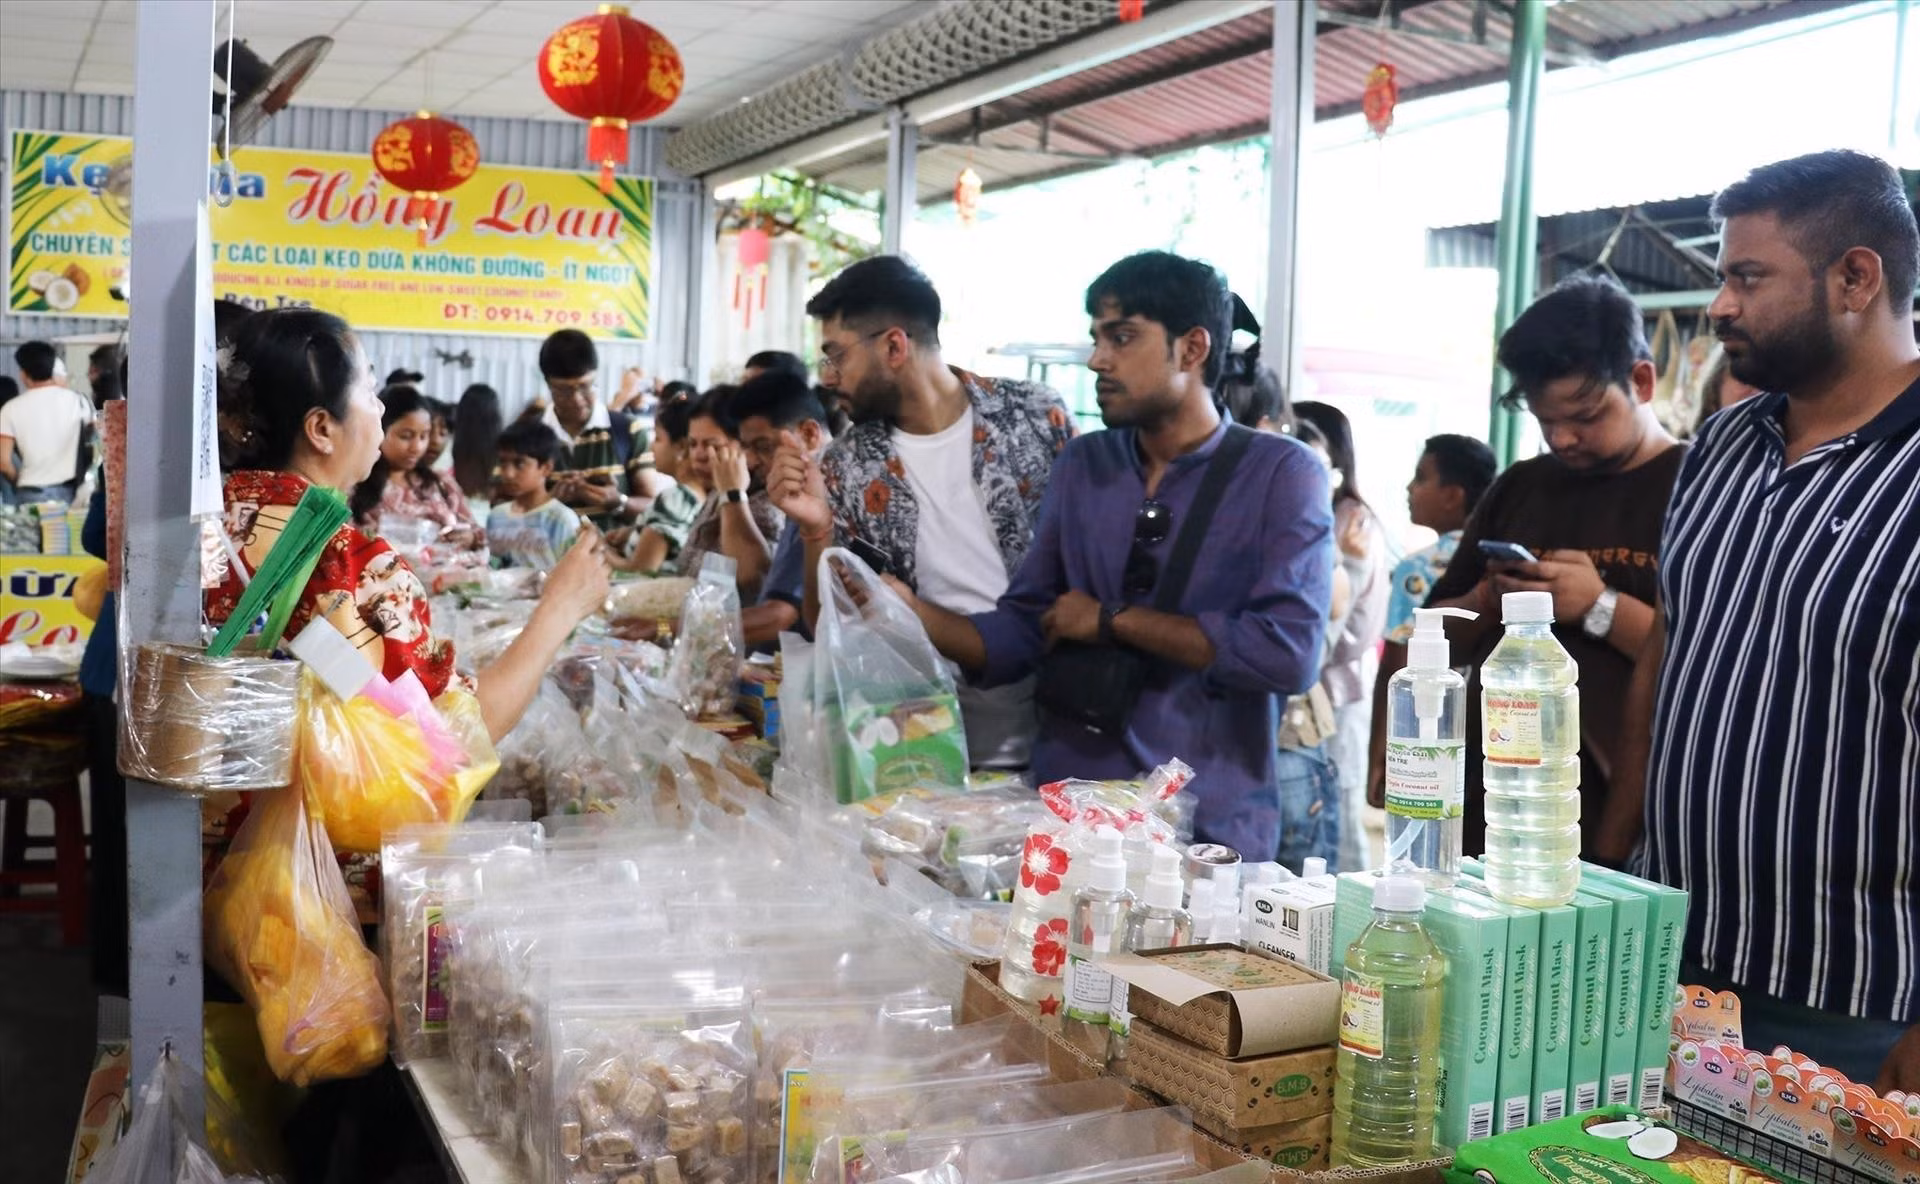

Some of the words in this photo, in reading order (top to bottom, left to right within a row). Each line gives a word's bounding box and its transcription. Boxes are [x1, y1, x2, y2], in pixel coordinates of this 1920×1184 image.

[474, 181, 621, 239] Loan
[31, 231, 113, 256] CHUYÊN
[228, 241, 267, 263] CÁC
[275, 246, 316, 270] LOẠI
[324, 249, 360, 274] KẸO
[367, 248, 404, 270] DỪA
[412, 251, 475, 274] KHÔNG
[483, 252, 544, 278] ĐƯỜNG
[586, 264, 630, 284] NGỌT
[1515, 944, 1526, 984] Mask
[1552, 940, 1563, 978] Mask
[1587, 933, 1598, 972] Mask
[1622, 927, 1633, 964] Mask
[1481, 948, 1494, 987] Mask
[1650, 963, 1668, 1030] Coconut
[1660, 921, 1674, 958] Mask
[1546, 983, 1560, 1052] Coconut
[1580, 977, 1595, 1045] Coconut
[1615, 970, 1630, 1037] Coconut
[1474, 993, 1490, 1064] Coconut
[1509, 988, 1524, 1059] Coconut
[1277, 1081, 1308, 1093] B.M.B
[1681, 1076, 1724, 1100] Lipbalm
[1755, 1104, 1802, 1130] Lipbalm
[1845, 1143, 1896, 1173] Lipbalm
